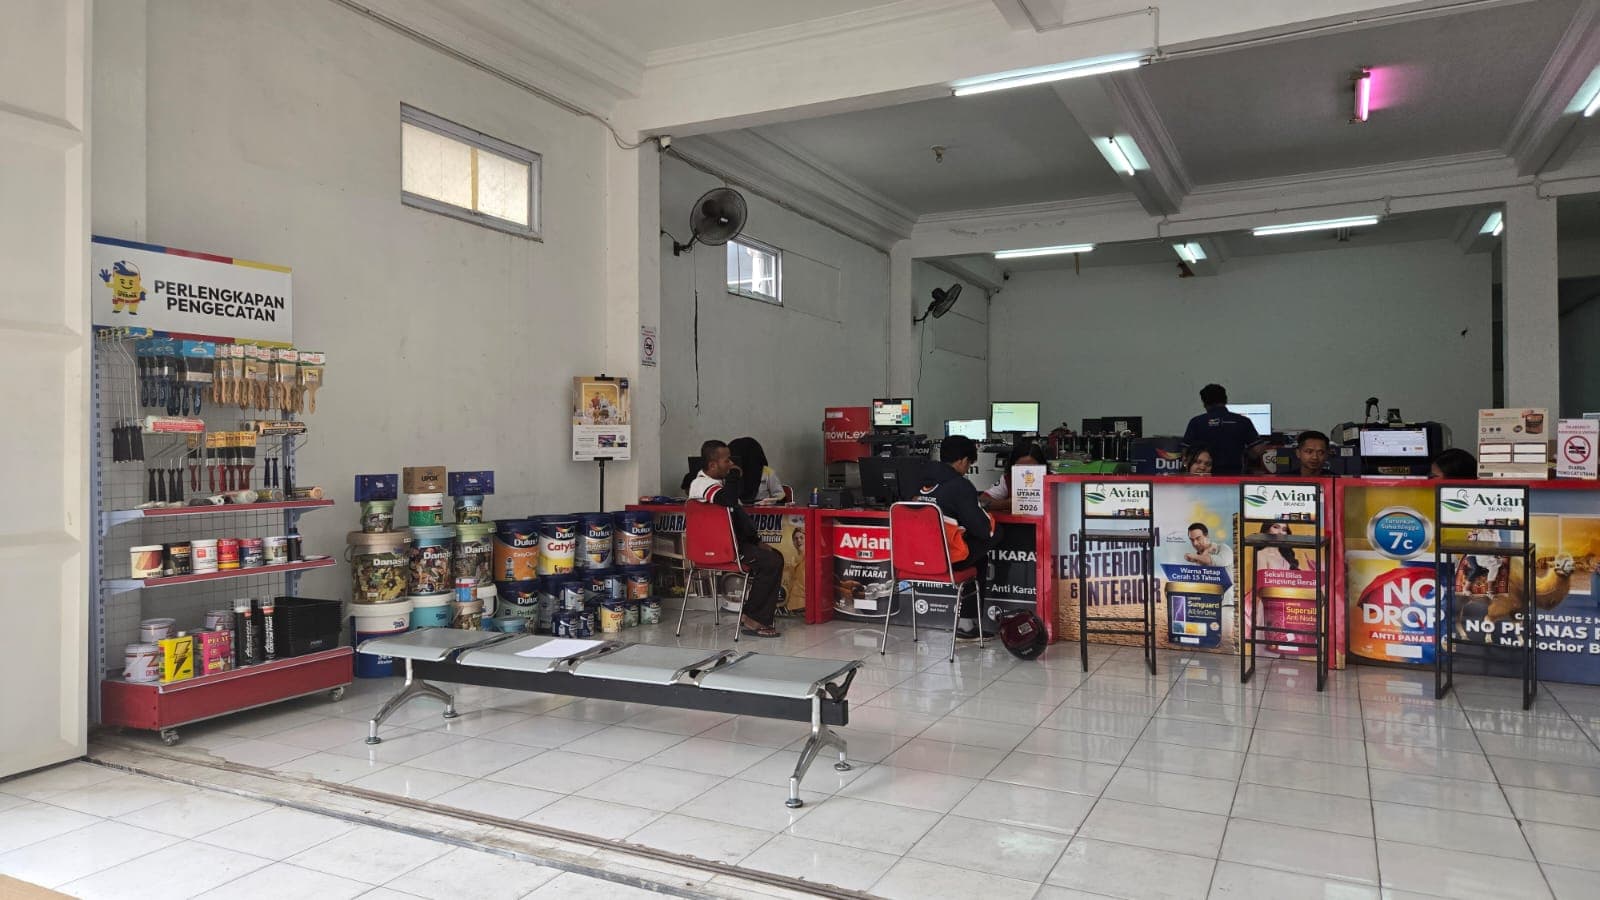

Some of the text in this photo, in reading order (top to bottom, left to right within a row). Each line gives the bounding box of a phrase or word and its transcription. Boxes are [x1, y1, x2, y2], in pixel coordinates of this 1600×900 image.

[154, 279, 285, 309] PERLENGKAPAN
[166, 296, 276, 322] PENGECATAN
[1155, 457, 1182, 470] Dul
[1109, 486, 1151, 499] Avian
[1271, 489, 1317, 502] Avian
[1474, 493, 1525, 507] Avian
[1019, 504, 1039, 512] 2026
[839, 532, 891, 550] Avian
[843, 568, 888, 578] ANTI KARAT
[592, 584, 605, 592] Dul
[1264, 578, 1296, 586] Langsung
[991, 583, 1010, 593] Anti
[1012, 585, 1037, 595] Karat
[1383, 577, 1445, 606] NO
[1187, 601, 1220, 609] Sunguard
[1362, 603, 1445, 628] DROP
[1537, 614, 1582, 624] PELAPIS
[1465, 619, 1495, 633] NO
[1371, 631, 1395, 641] ANTI
[1398, 633, 1433, 643] PANAS
